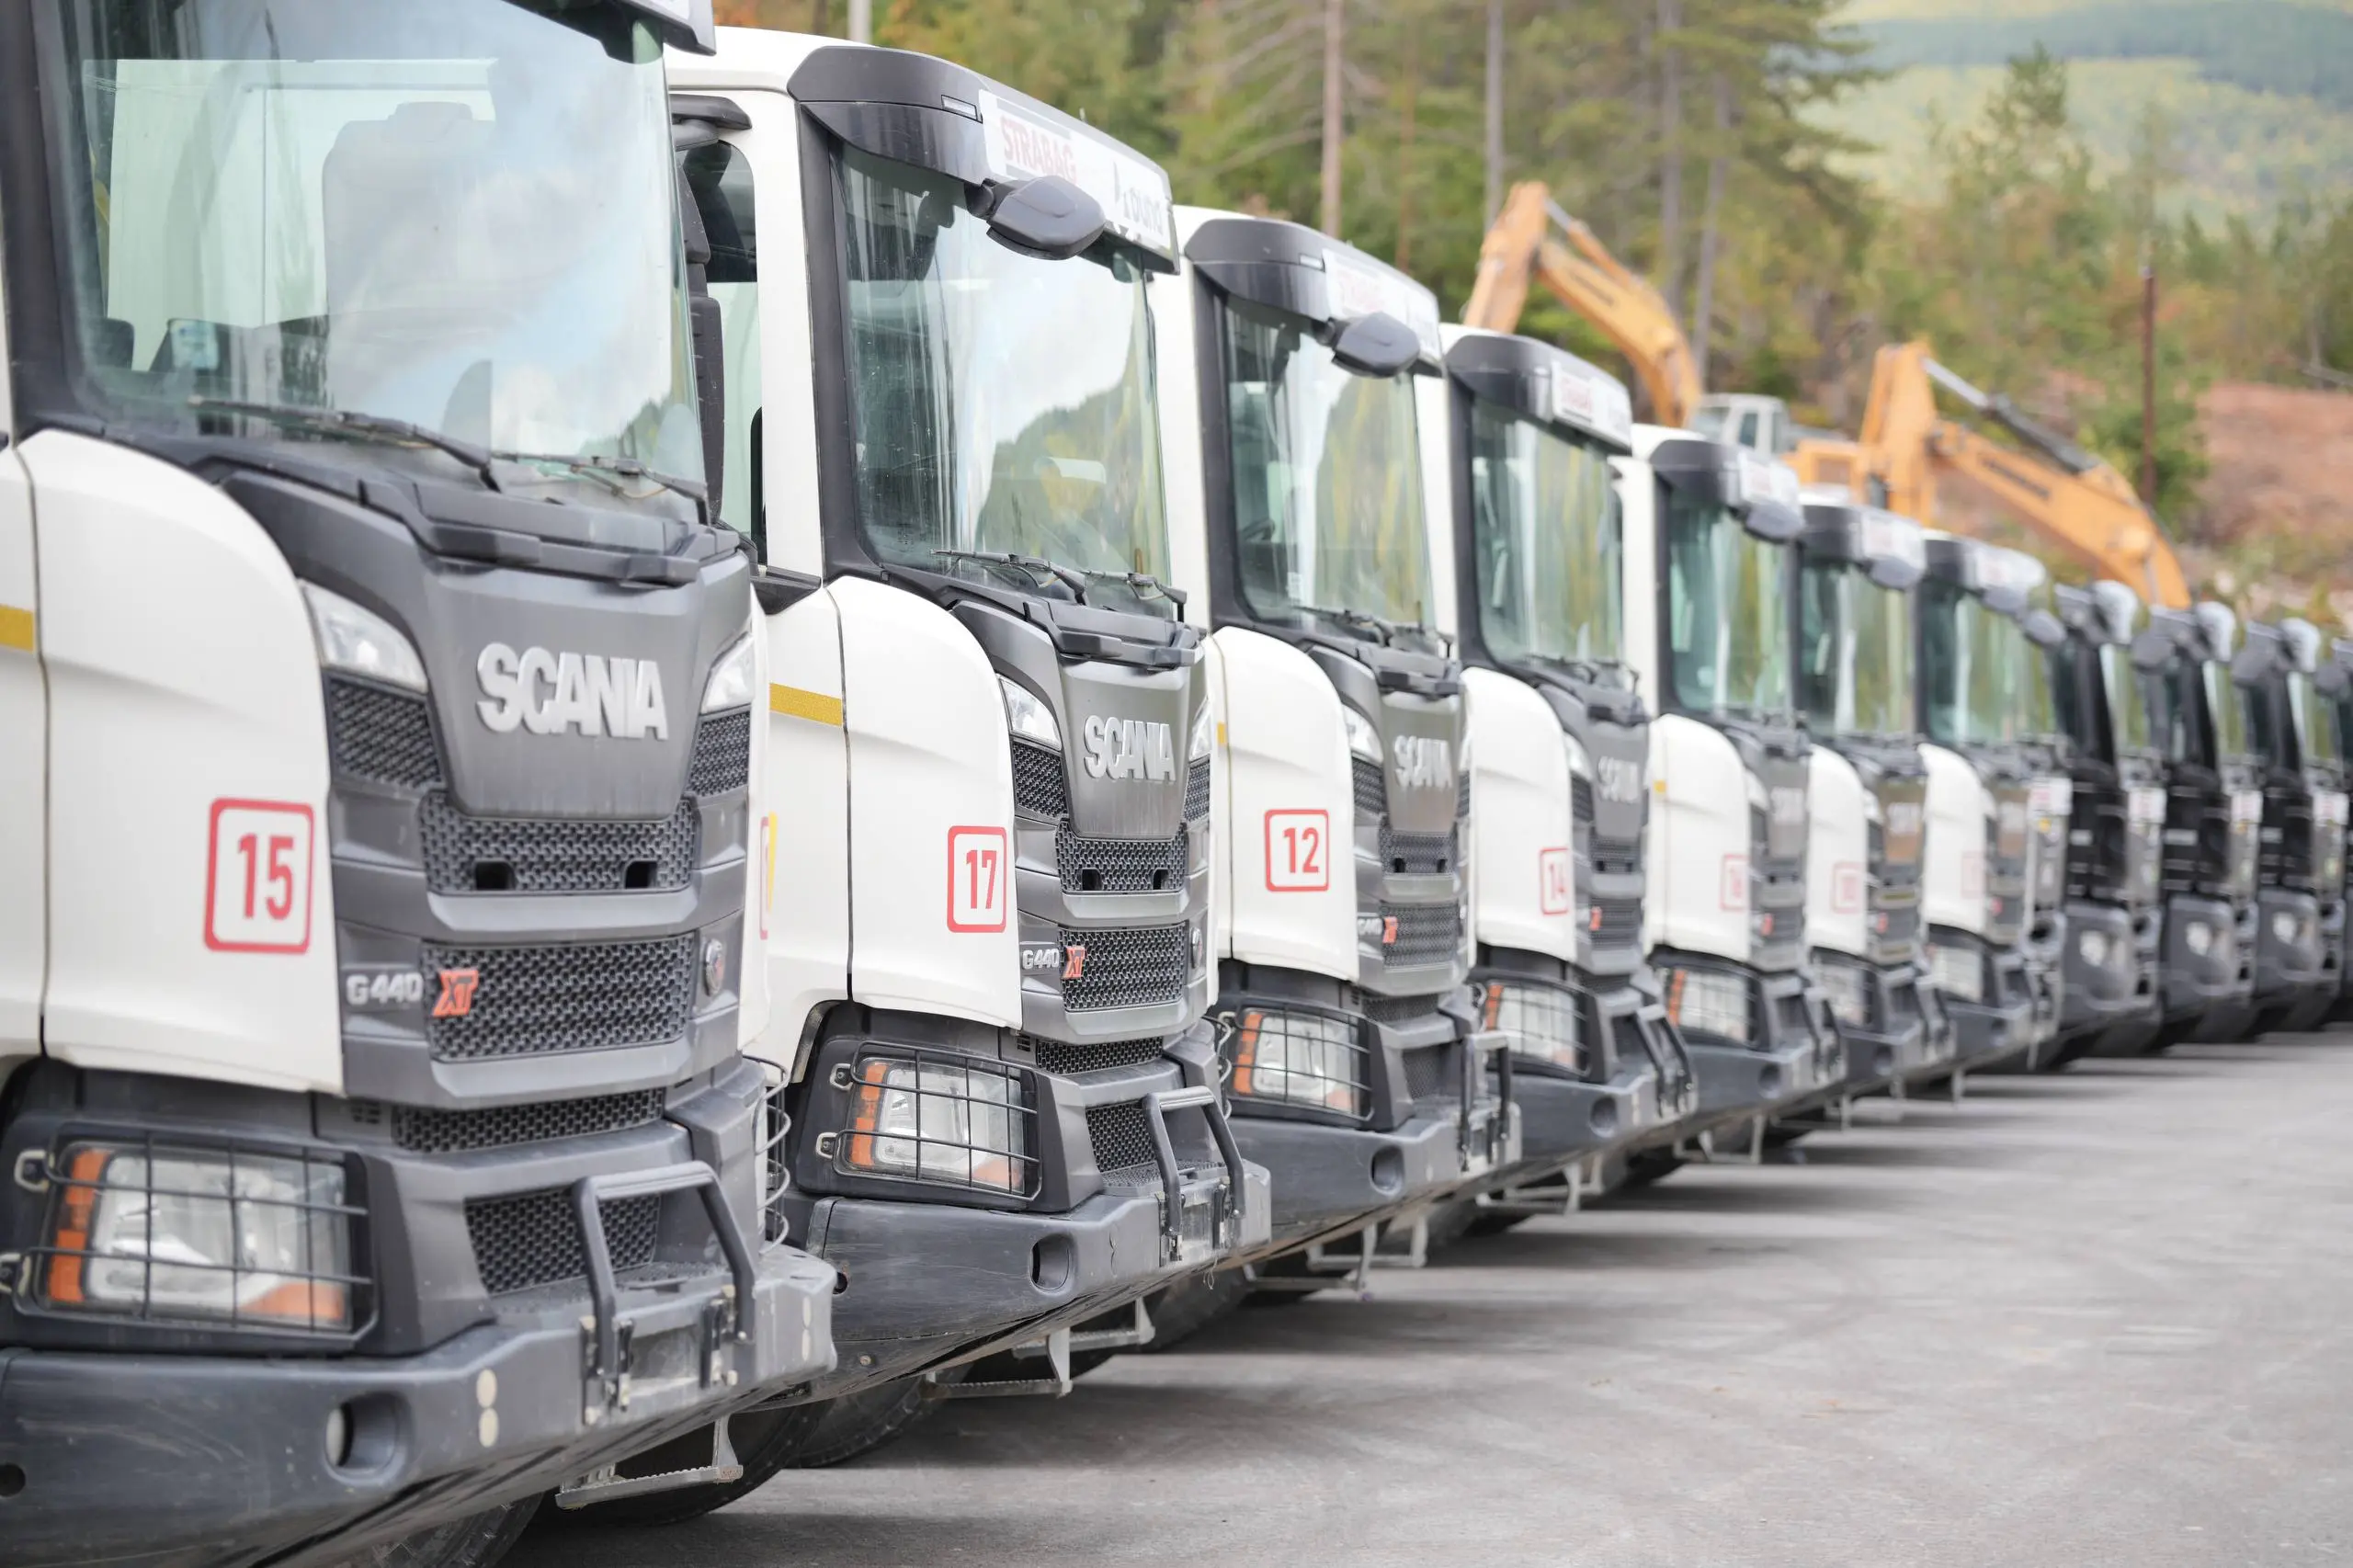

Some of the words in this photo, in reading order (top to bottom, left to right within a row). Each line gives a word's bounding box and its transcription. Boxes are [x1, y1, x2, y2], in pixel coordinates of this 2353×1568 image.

[1000, 115, 1077, 184] STRABAG
[475, 642, 669, 741] SCANIA
[1084, 715, 1176, 781] SCANIA
[237, 832, 295, 920] 15
[966, 849, 997, 909] 17
[1283, 827, 1320, 873] 12
[346, 971, 424, 1006] G440
[431, 968, 479, 1018] XT
[1022, 948, 1060, 971] G440
[1062, 945, 1086, 980] XT
